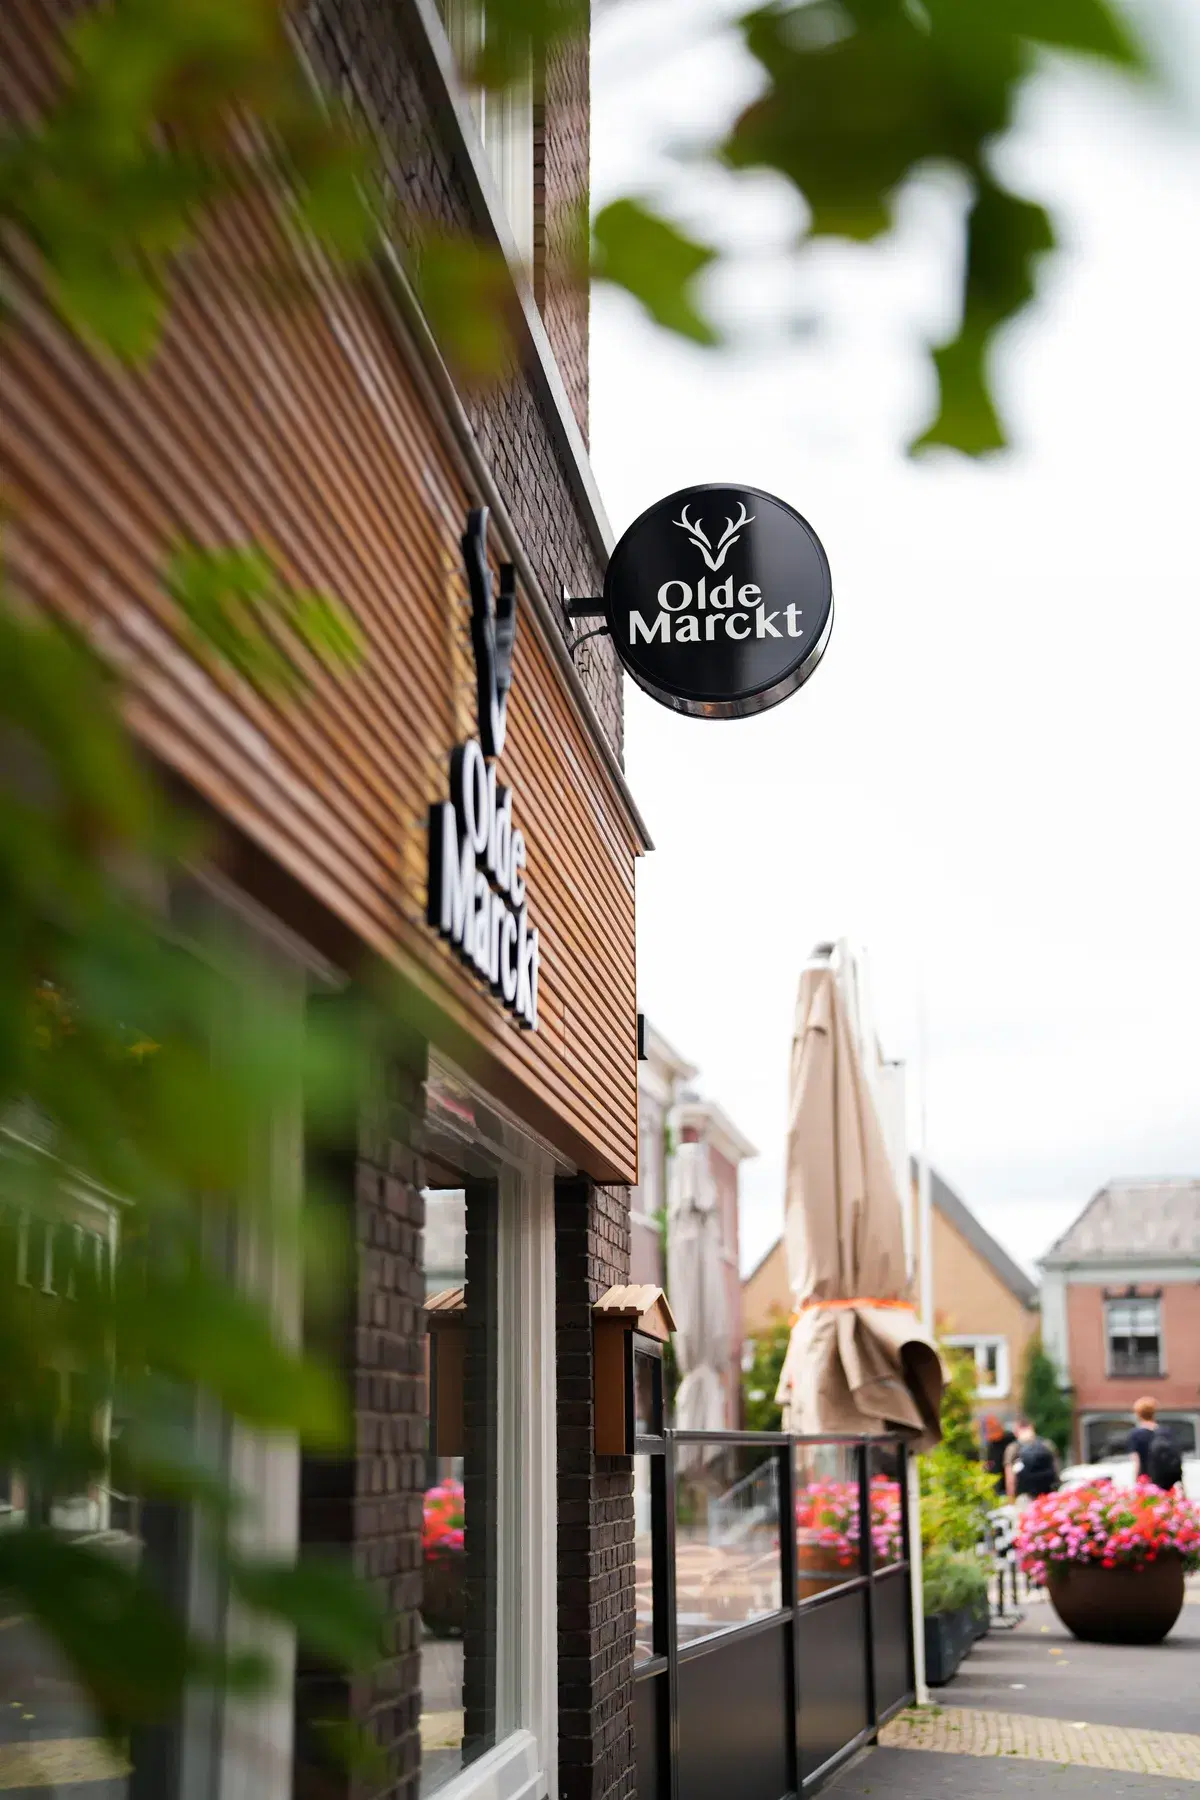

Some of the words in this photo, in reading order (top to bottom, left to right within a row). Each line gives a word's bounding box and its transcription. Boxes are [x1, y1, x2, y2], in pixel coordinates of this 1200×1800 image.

[629, 603, 804, 645] Marckt
[657, 575, 762, 612] Olde
[460, 739, 527, 907] Olde
[439, 800, 541, 1031] Marckt
